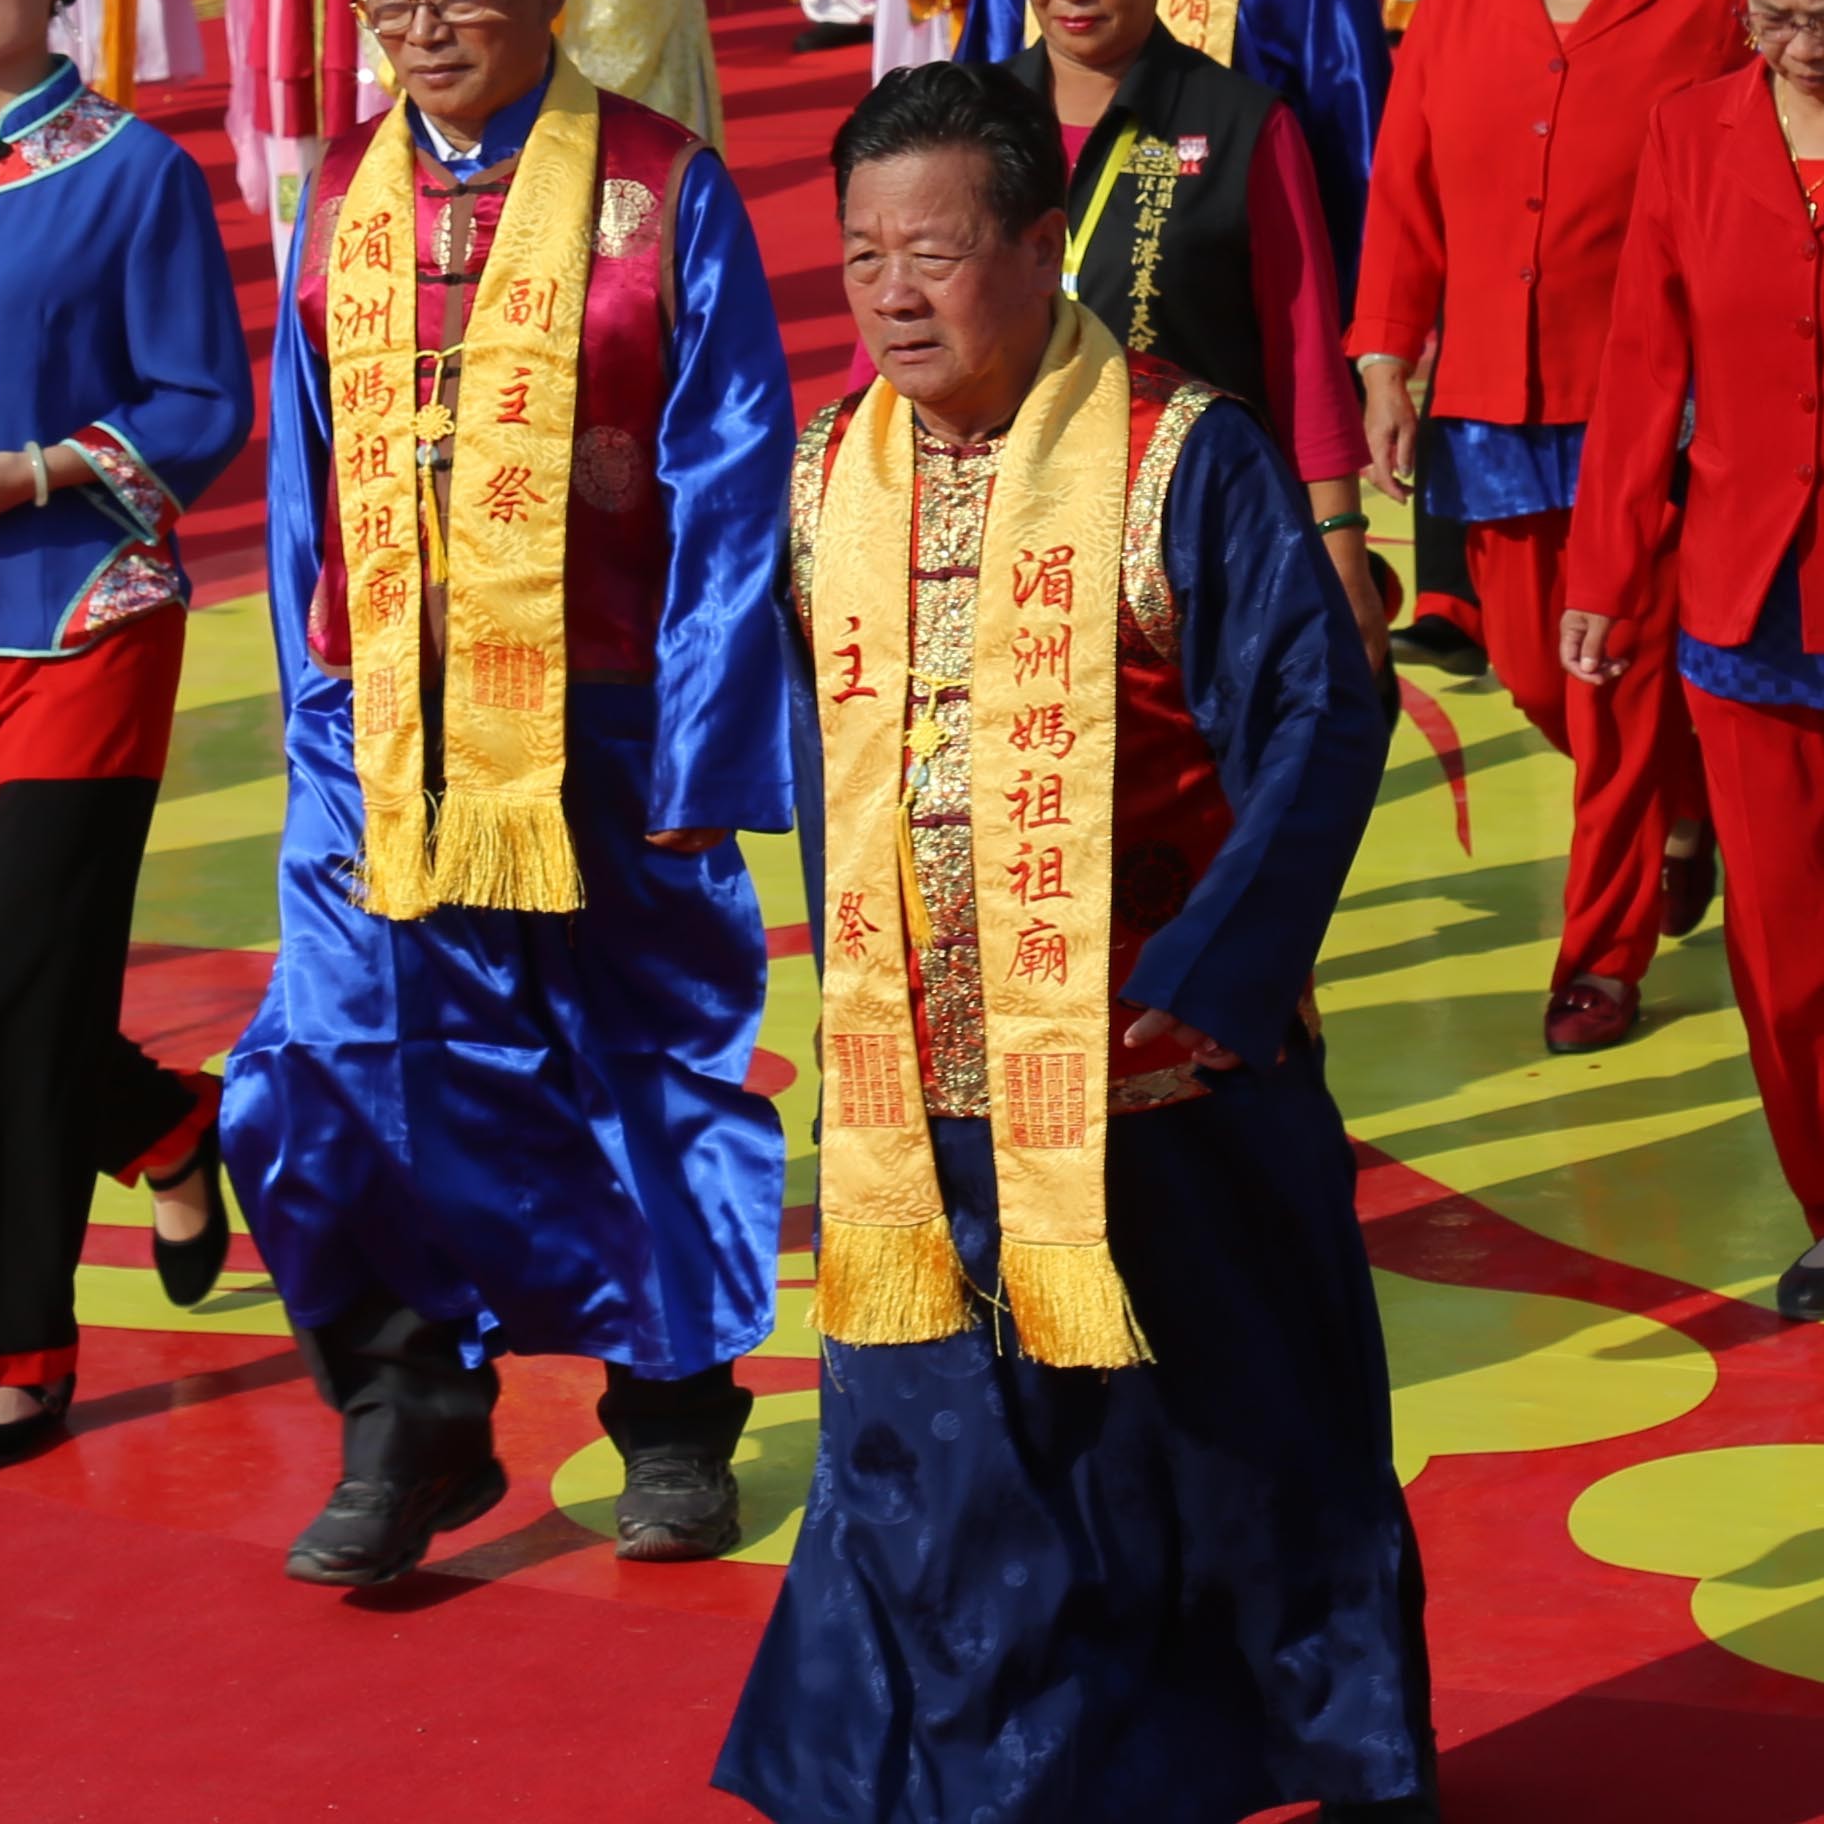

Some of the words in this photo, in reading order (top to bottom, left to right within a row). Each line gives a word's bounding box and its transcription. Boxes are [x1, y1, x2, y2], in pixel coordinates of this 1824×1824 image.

[333, 212, 407, 627] 湄洲媽祖祖廟
[477, 278, 559, 525] 副主祭
[1002, 544, 1077, 986] 湄洲媽祖祖廟
